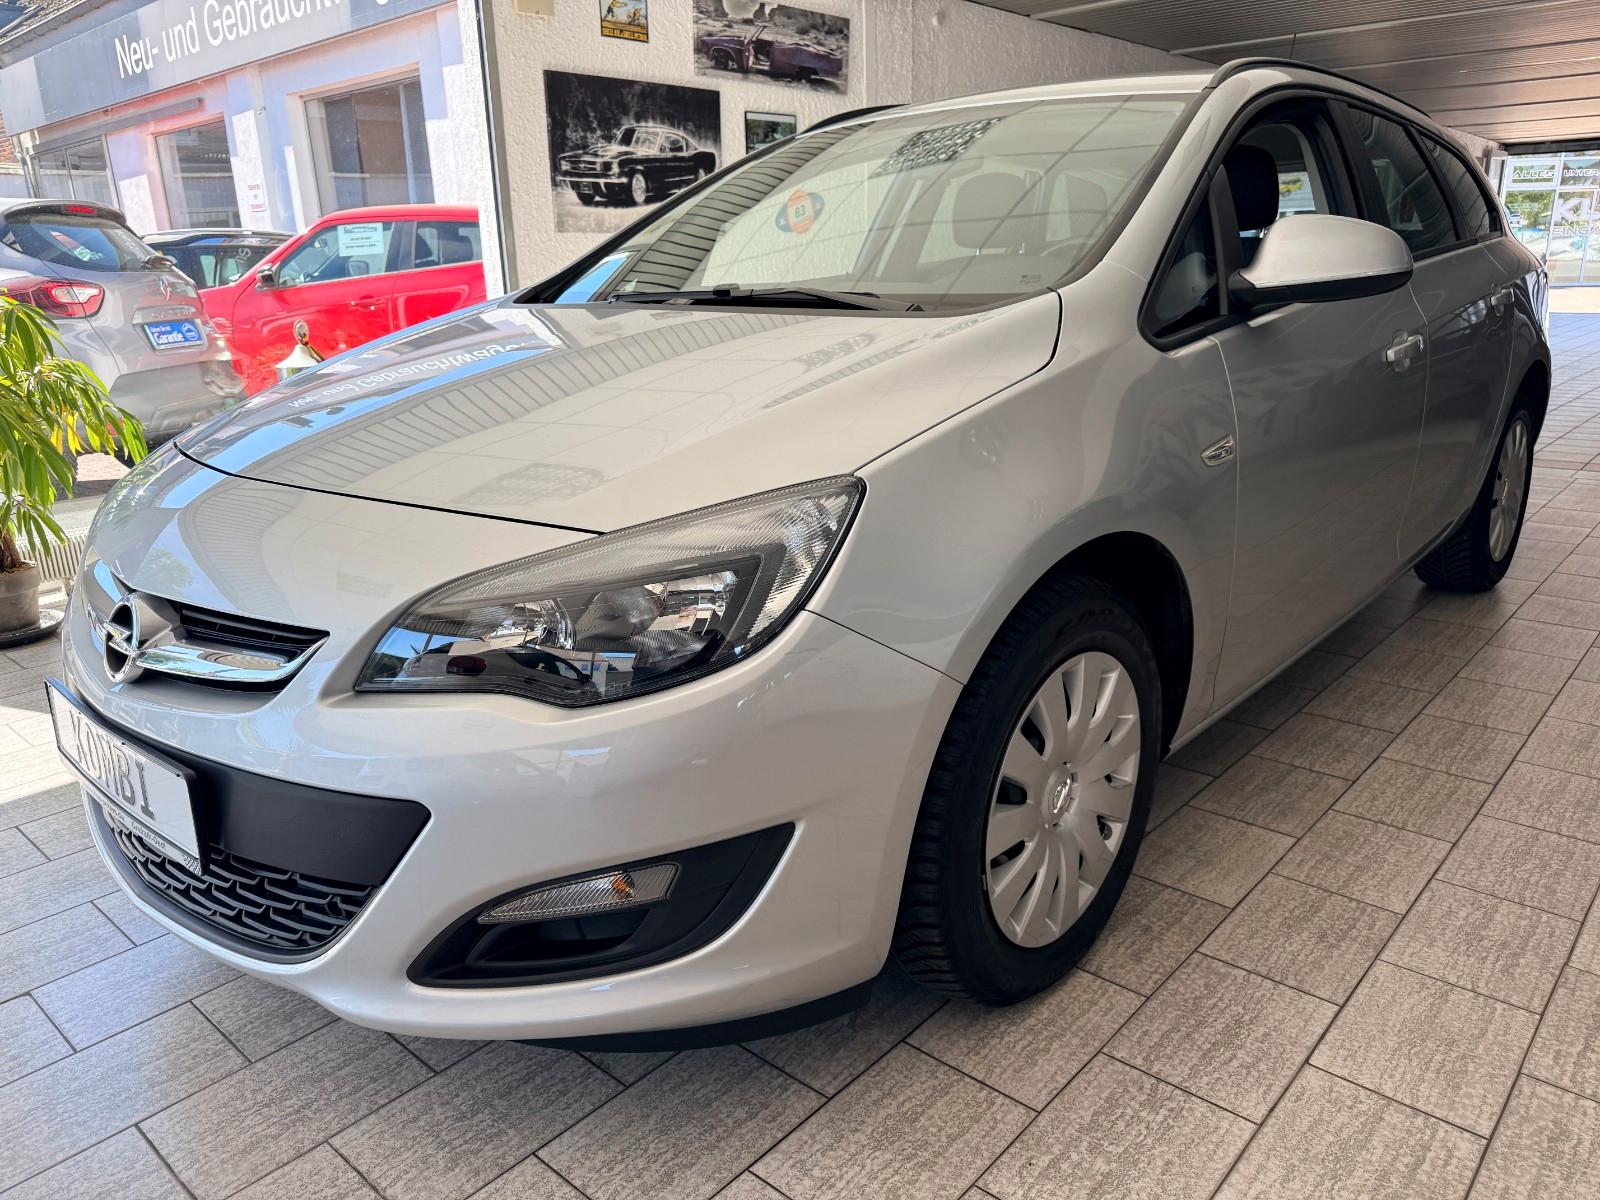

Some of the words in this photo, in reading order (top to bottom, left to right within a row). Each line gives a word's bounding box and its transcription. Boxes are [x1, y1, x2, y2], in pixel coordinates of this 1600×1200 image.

[114, 34, 159, 79] Neu-
[162, 6, 200, 62] und
[1513, 169, 1554, 178] ALLES
[794, 203, 806, 218] 83
[69, 709, 154, 819] KOMBI
